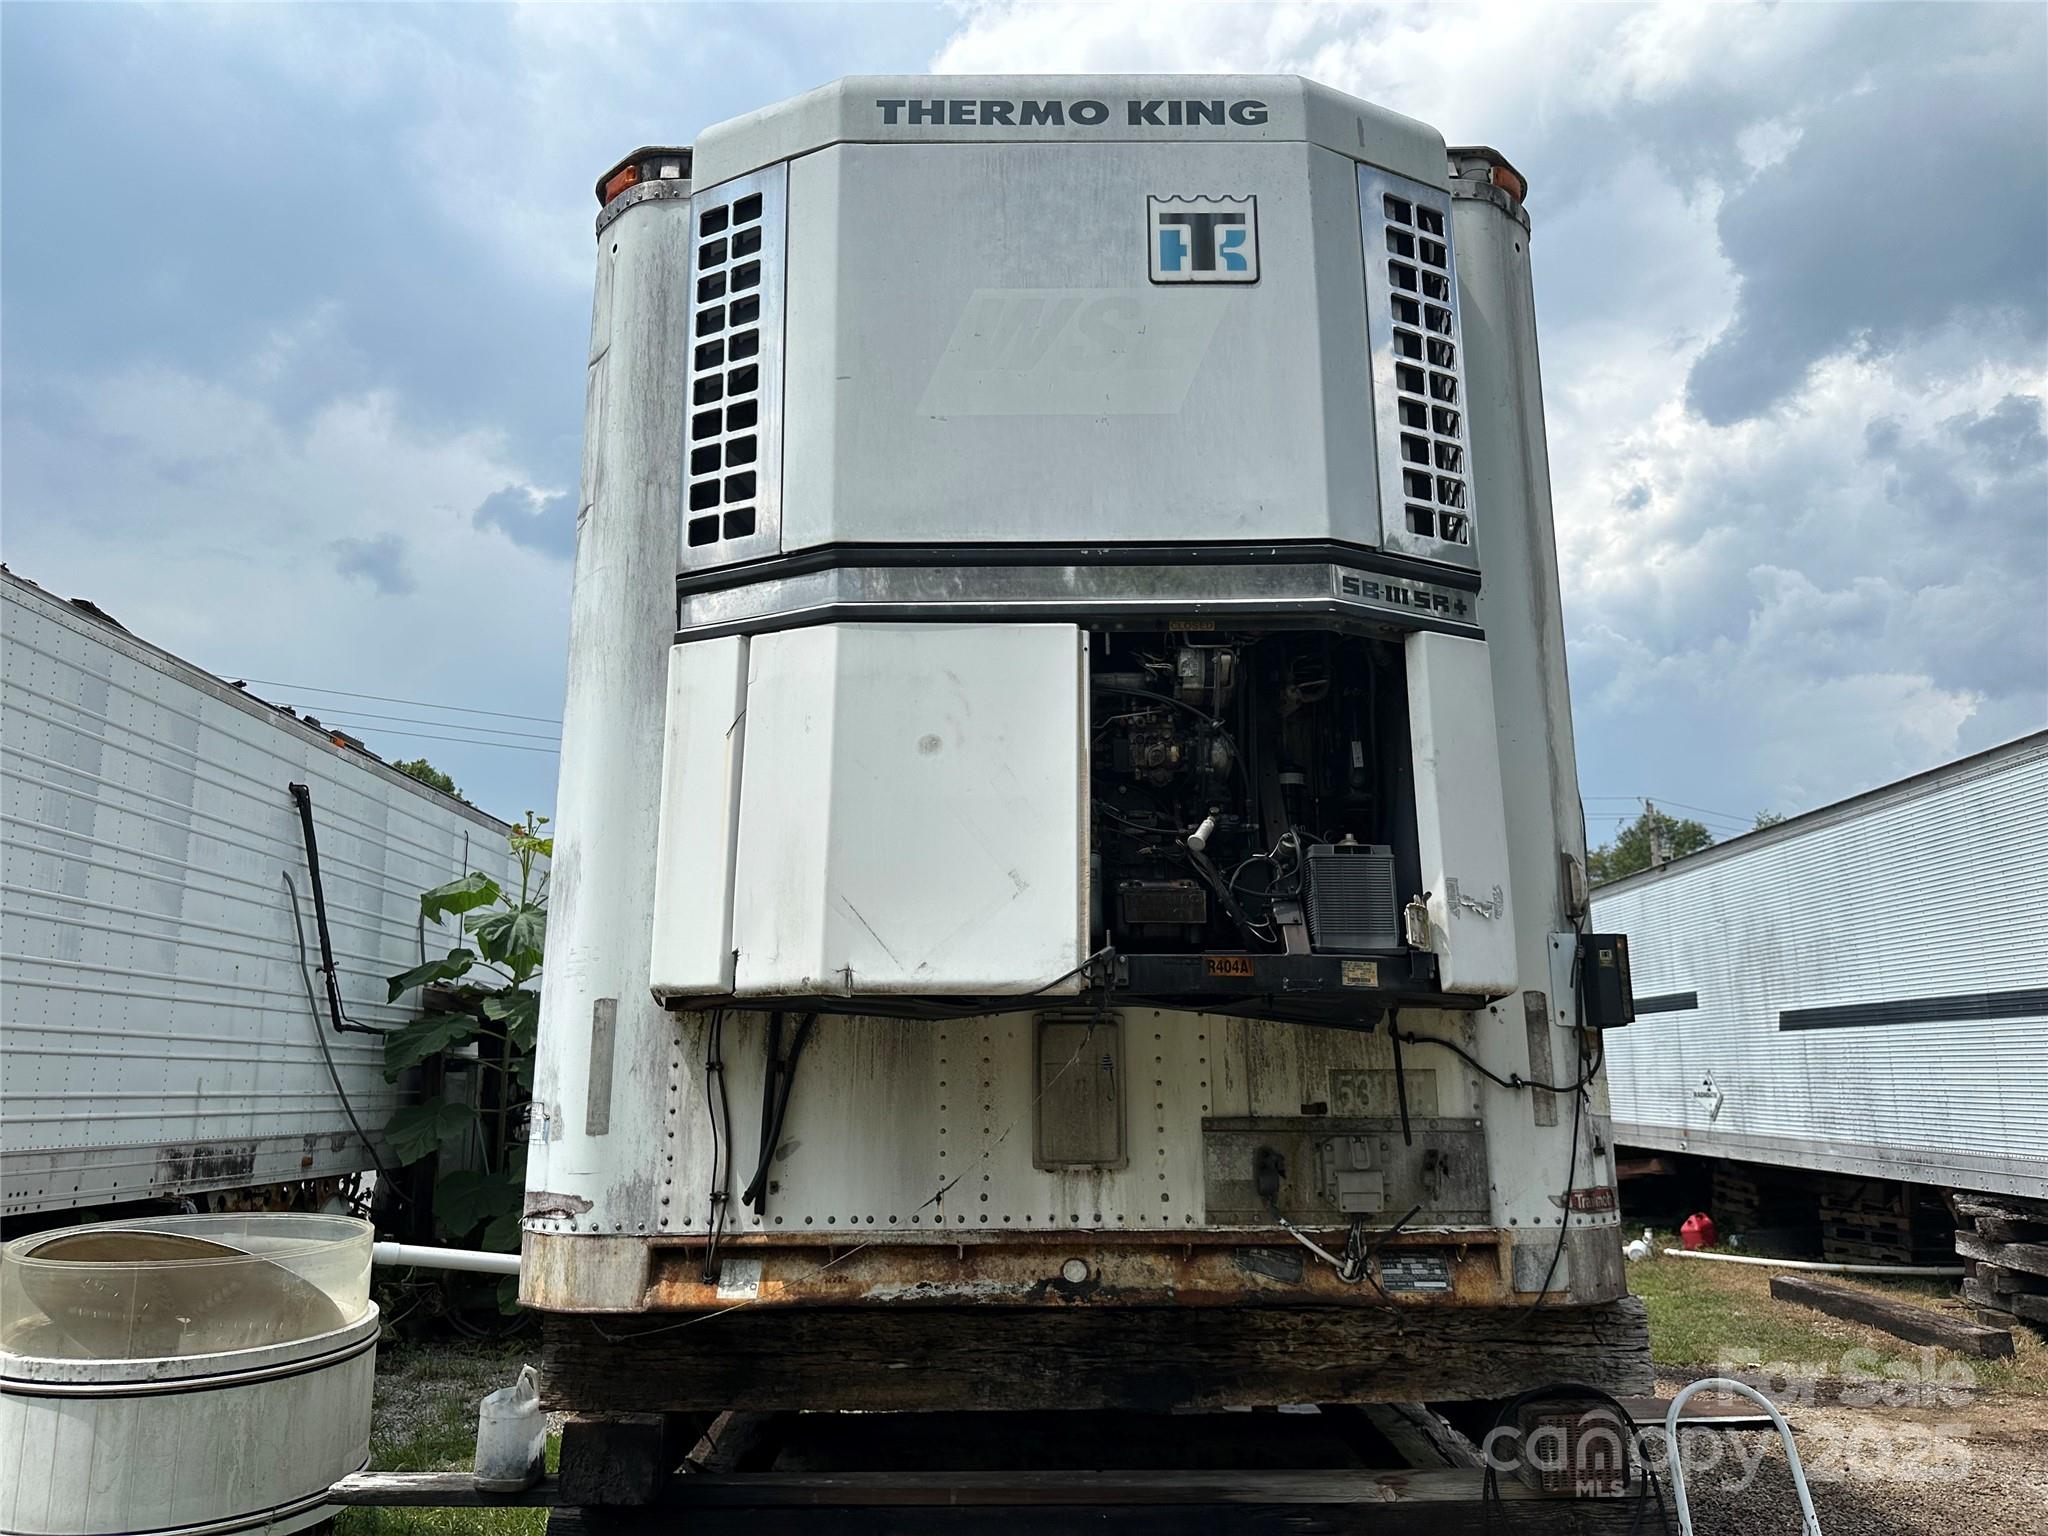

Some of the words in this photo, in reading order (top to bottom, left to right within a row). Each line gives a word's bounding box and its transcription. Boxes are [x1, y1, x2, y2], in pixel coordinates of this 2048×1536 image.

[876, 100, 1110, 126] THERMO
[1127, 100, 1269, 126] KING
[1207, 959, 1249, 974] R404A
